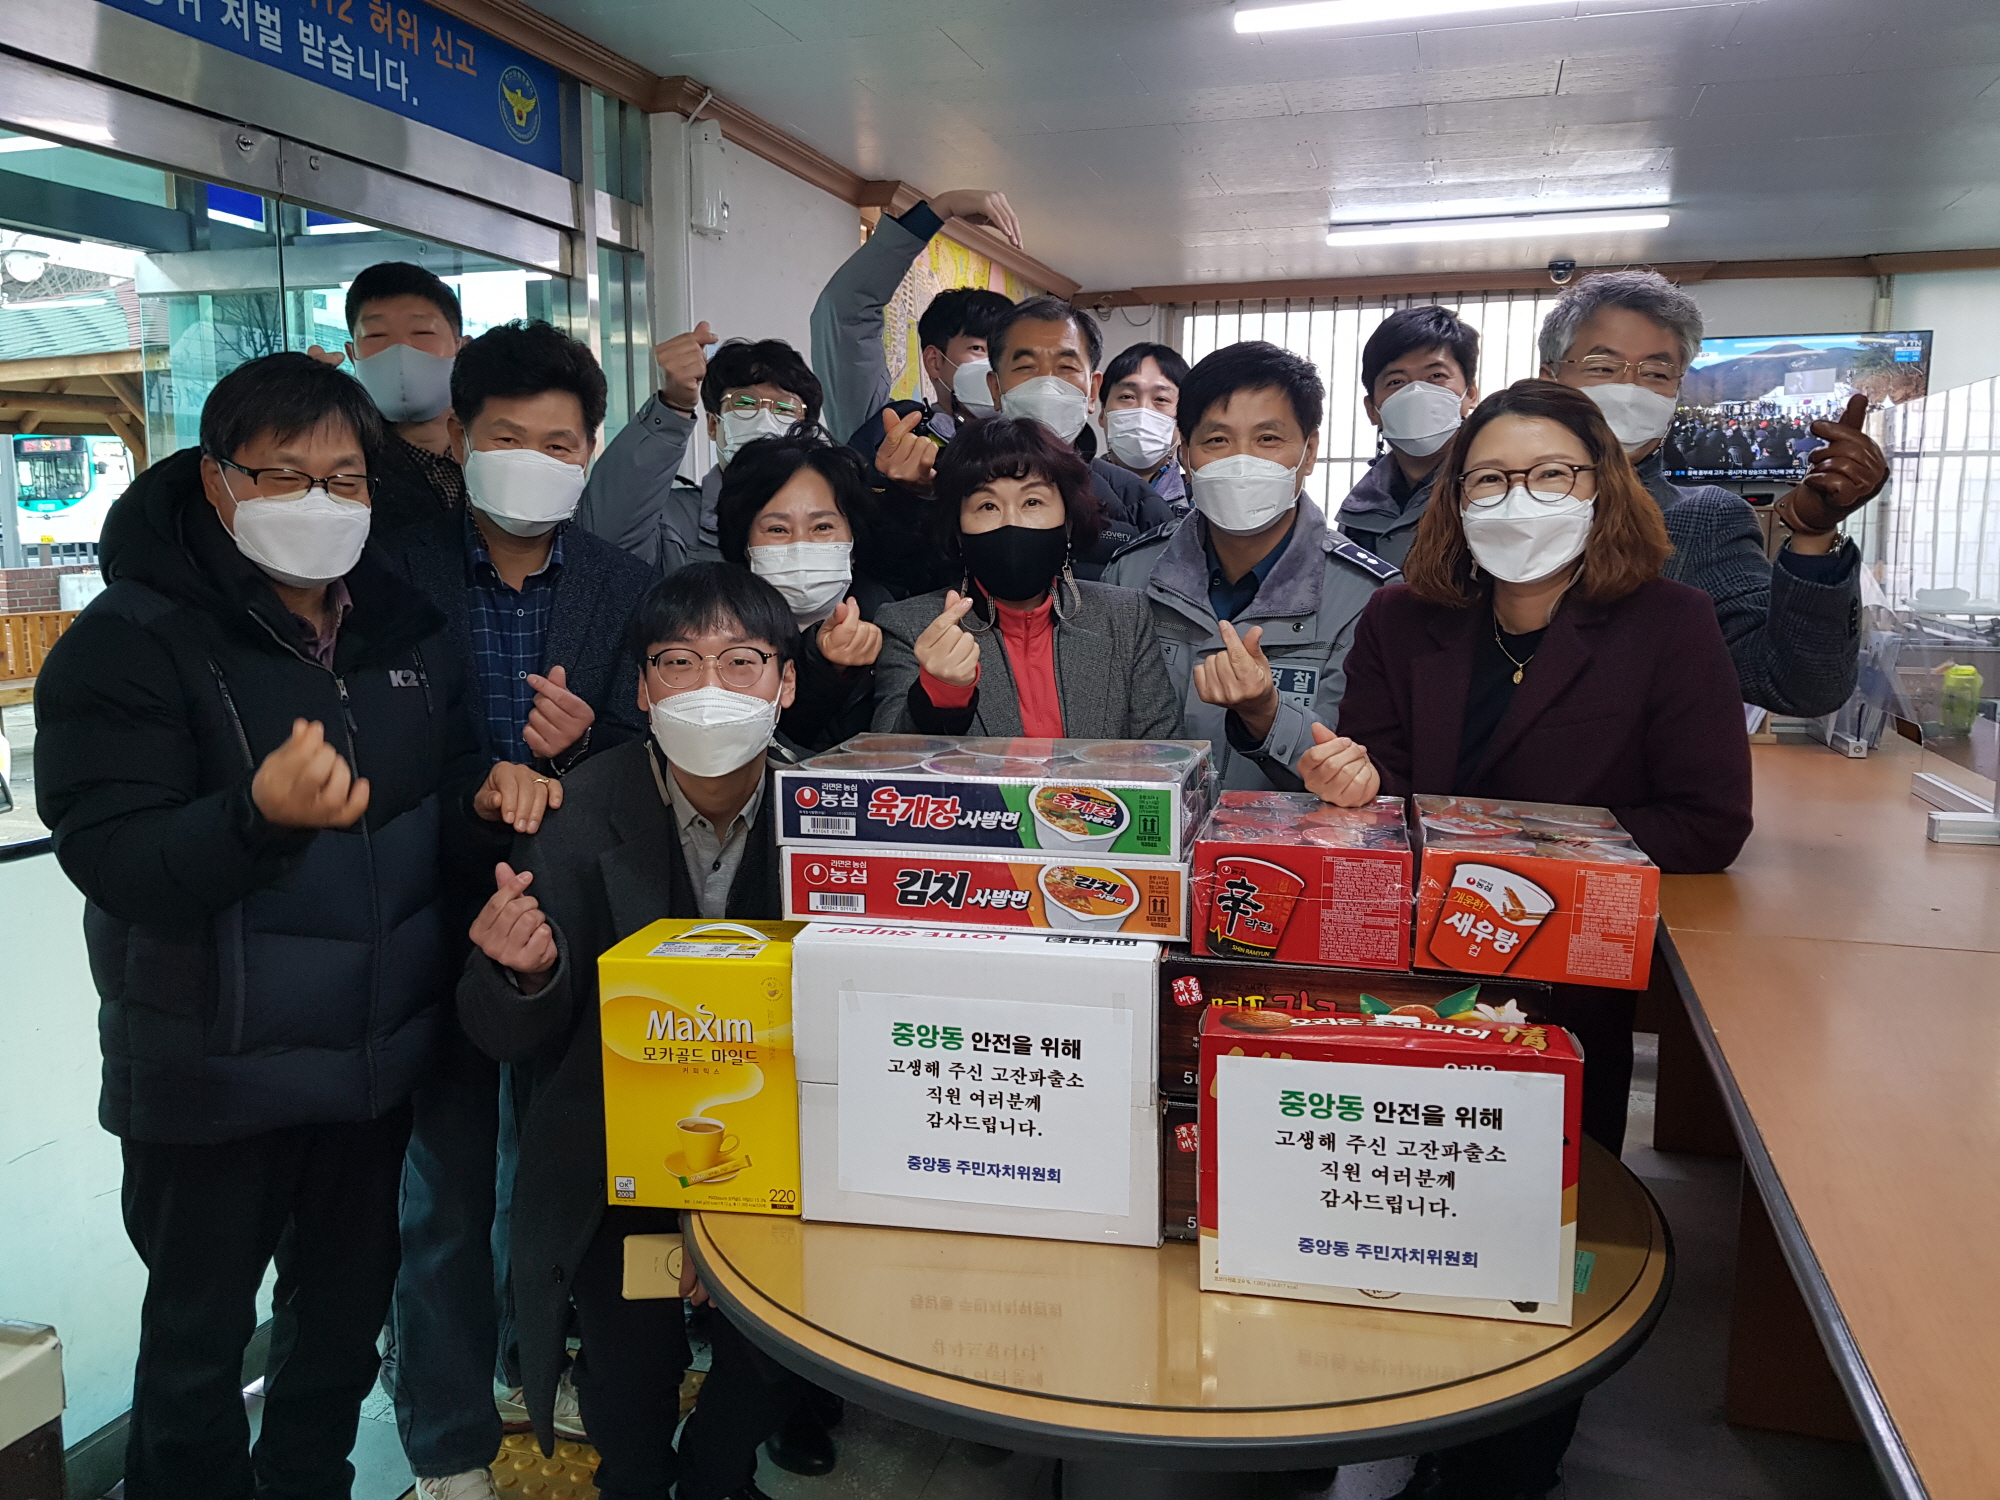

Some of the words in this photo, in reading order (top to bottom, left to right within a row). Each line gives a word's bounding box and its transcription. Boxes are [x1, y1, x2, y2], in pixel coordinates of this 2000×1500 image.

[369, 0, 419, 55] 허위
[432, 27, 478, 77] 신고
[298, 19, 419, 106] 받습니다.
[1101, 530, 1131, 542] covery
[389, 669, 419, 688] K2
[820, 790, 859, 808] 농심
[821, 782, 843, 791] 라면은
[843, 783, 858, 792] 농심
[868, 786, 961, 829] 육개장
[958, 811, 1023, 831] 사발면
[1052, 792, 1118, 819] 육개장
[829, 867, 868, 884] 농심
[830, 859, 852, 868] 라면은
[852, 860, 867, 869] 농심
[893, 868, 971, 910] 김치
[967, 888, 1032, 911] 사발면
[1073, 874, 1121, 896] 김치
[1216, 876, 1265, 937] 辛
[1452, 890, 1492, 914] 개운한!
[817, 925, 919, 937] super
[922, 931, 1006, 941] LOTTE
[1244, 917, 1273, 934] 라면
[1442, 910, 1521, 954] 새우탕
[1231, 943, 1246, 954] SHIN
[1245, 948, 1271, 958] RAMYUN
[1467, 943, 1482, 958] 컵
[646, 1004, 754, 1043] Maxim
[891, 1021, 965, 1051] 중앙동
[971, 1031, 1033, 1056] 안전을
[1040, 1037, 1082, 1060] 위해
[642, 1046, 706, 1065] 모카골드
[711, 1048, 761, 1066] 마일드
[887, 1058, 940, 1079] 고생해
[947, 1061, 983, 1082] 주신
[990, 1066, 1085, 1089] 고잔파출소
[925, 1085, 961, 1106] 직원
[969, 1089, 1042, 1113] 여러분께
[1278, 1089, 1365, 1122] 중앙동
[1373, 1100, 1446, 1127] 안전을
[1454, 1105, 1504, 1131] 위해
[925, 1111, 1043, 1138] 감사드립니다.
[1274, 1128, 1337, 1153] 고생해
[1345, 1134, 1387, 1157] 주신
[1396, 1139, 1508, 1164] 고잔파출소
[906, 1154, 952, 1173] 중앙동
[956, 1159, 1062, 1184] 주민자치위원회
[1319, 1160, 1362, 1183] 직원
[1371, 1165, 1456, 1191] 여러분께
[769, 1188, 796, 1204] 220
[1319, 1188, 1458, 1219] 감사드립니다.
[1297, 1236, 1350, 1258] 중앙동
[1355, 1242, 1479, 1269] 주민자치위원회
